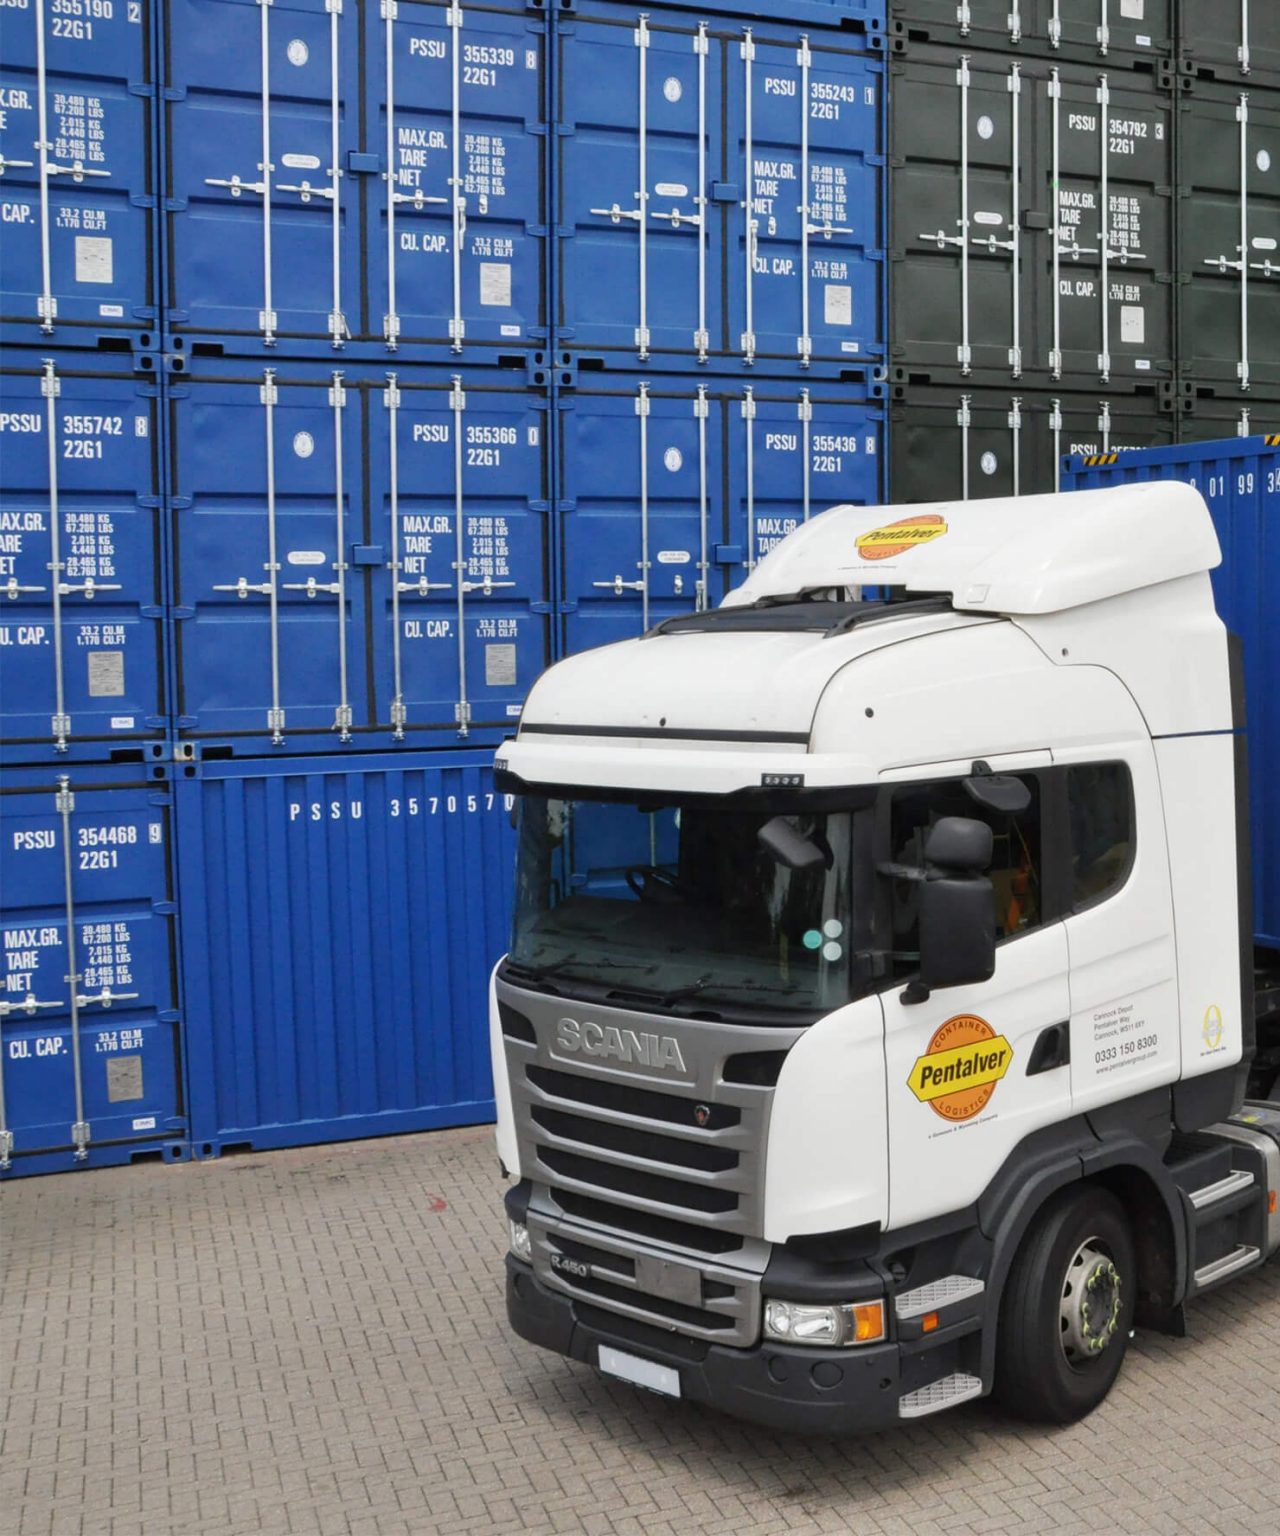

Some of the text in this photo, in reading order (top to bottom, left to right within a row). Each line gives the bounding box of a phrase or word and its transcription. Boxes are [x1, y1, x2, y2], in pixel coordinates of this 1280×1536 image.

[52, 19, 92, 40] 22G1
[410, 38, 446, 58] PSSU
[463, 45, 514, 67] 355339
[463, 67, 496, 87] 22G1
[765, 77, 796, 97] PSSU
[811, 83, 854, 103] 355243
[811, 102, 839, 120] 22G1
[1069, 114, 1096, 132] PSSU
[1109, 119, 1147, 138] 354792
[398, 128, 448, 150] MAX.GR.
[1109, 138, 1134, 154] 22G1
[399, 149, 427, 168] TARE
[399, 169, 421, 187] NET
[754, 160, 796, 181] MAX.GR.
[755, 180, 779, 197] TARE
[754, 198, 774, 215] NET
[1059, 191, 1096, 209] MAX.GR.
[2, 203, 34, 224] CAP.
[1060, 209, 1081, 225] TARE
[1059, 226, 1077, 241] NET
[400, 233, 449, 253] CU. CAP.
[773, 258, 796, 276] CAP.
[1059, 281, 1096, 298] CU. CAP.
[0, 414, 41, 433] PSSU
[64, 416, 122, 435] 355742
[414, 425, 449, 443] PSSU
[467, 426, 517, 445] 355366
[766, 433, 797, 451] PSSU
[813, 435, 857, 453] 355436
[64, 440, 102, 459] 22G1
[467, 449, 500, 467] 22G1
[813, 456, 841, 473] 22G1
[0, 513, 46, 532] AX.GR.
[98, 514, 110, 524] KG
[403, 516, 452, 534] MAX.GR.
[757, 518, 797, 536] MAX.GR
[98, 524, 113, 534] LBS
[0, 535, 22, 553] ARE
[98, 536, 111, 545] KG
[404, 536, 432, 554] TARE
[99, 545, 114, 555] LBS
[0, 557, 15, 575] ET
[99, 557, 111, 567] KG
[404, 556, 426, 573] NET
[99, 567, 115, 577] LBS
[0, 627, 49, 646] U. CAP.
[103, 626, 124, 636] CU.M
[404, 621, 453, 638] CU. CAP.
[103, 636, 126, 646] CU.FT
[290, 801, 362, 821] PSSU
[14, 831, 56, 851] PSSU
[78, 826, 137, 847] 354468
[80, 850, 118, 870] 22G1
[115, 923, 127, 933] KG
[5, 927, 62, 949] MAX.GR.
[115, 932, 130, 943] LBS
[117, 944, 128, 955] KG
[6, 951, 39, 971] TARE
[117, 954, 131, 965] LBS
[117, 965, 128, 975] KG
[7, 973, 32, 992] NET
[117, 974, 133, 985] LBS
[121, 1030, 142, 1041] CU.M
[933, 1021, 987, 1049] CONTAINER
[10, 1037, 68, 1059] CU. CAP.
[121, 1039, 144, 1051] CU.FT
[557, 1017, 687, 1073] SCANIA
[1095, 1034, 1158, 1064] 0333 150 8300
[920, 1049, 1007, 1090] Pentalver
[939, 1088, 990, 1116] LOGISTICS
